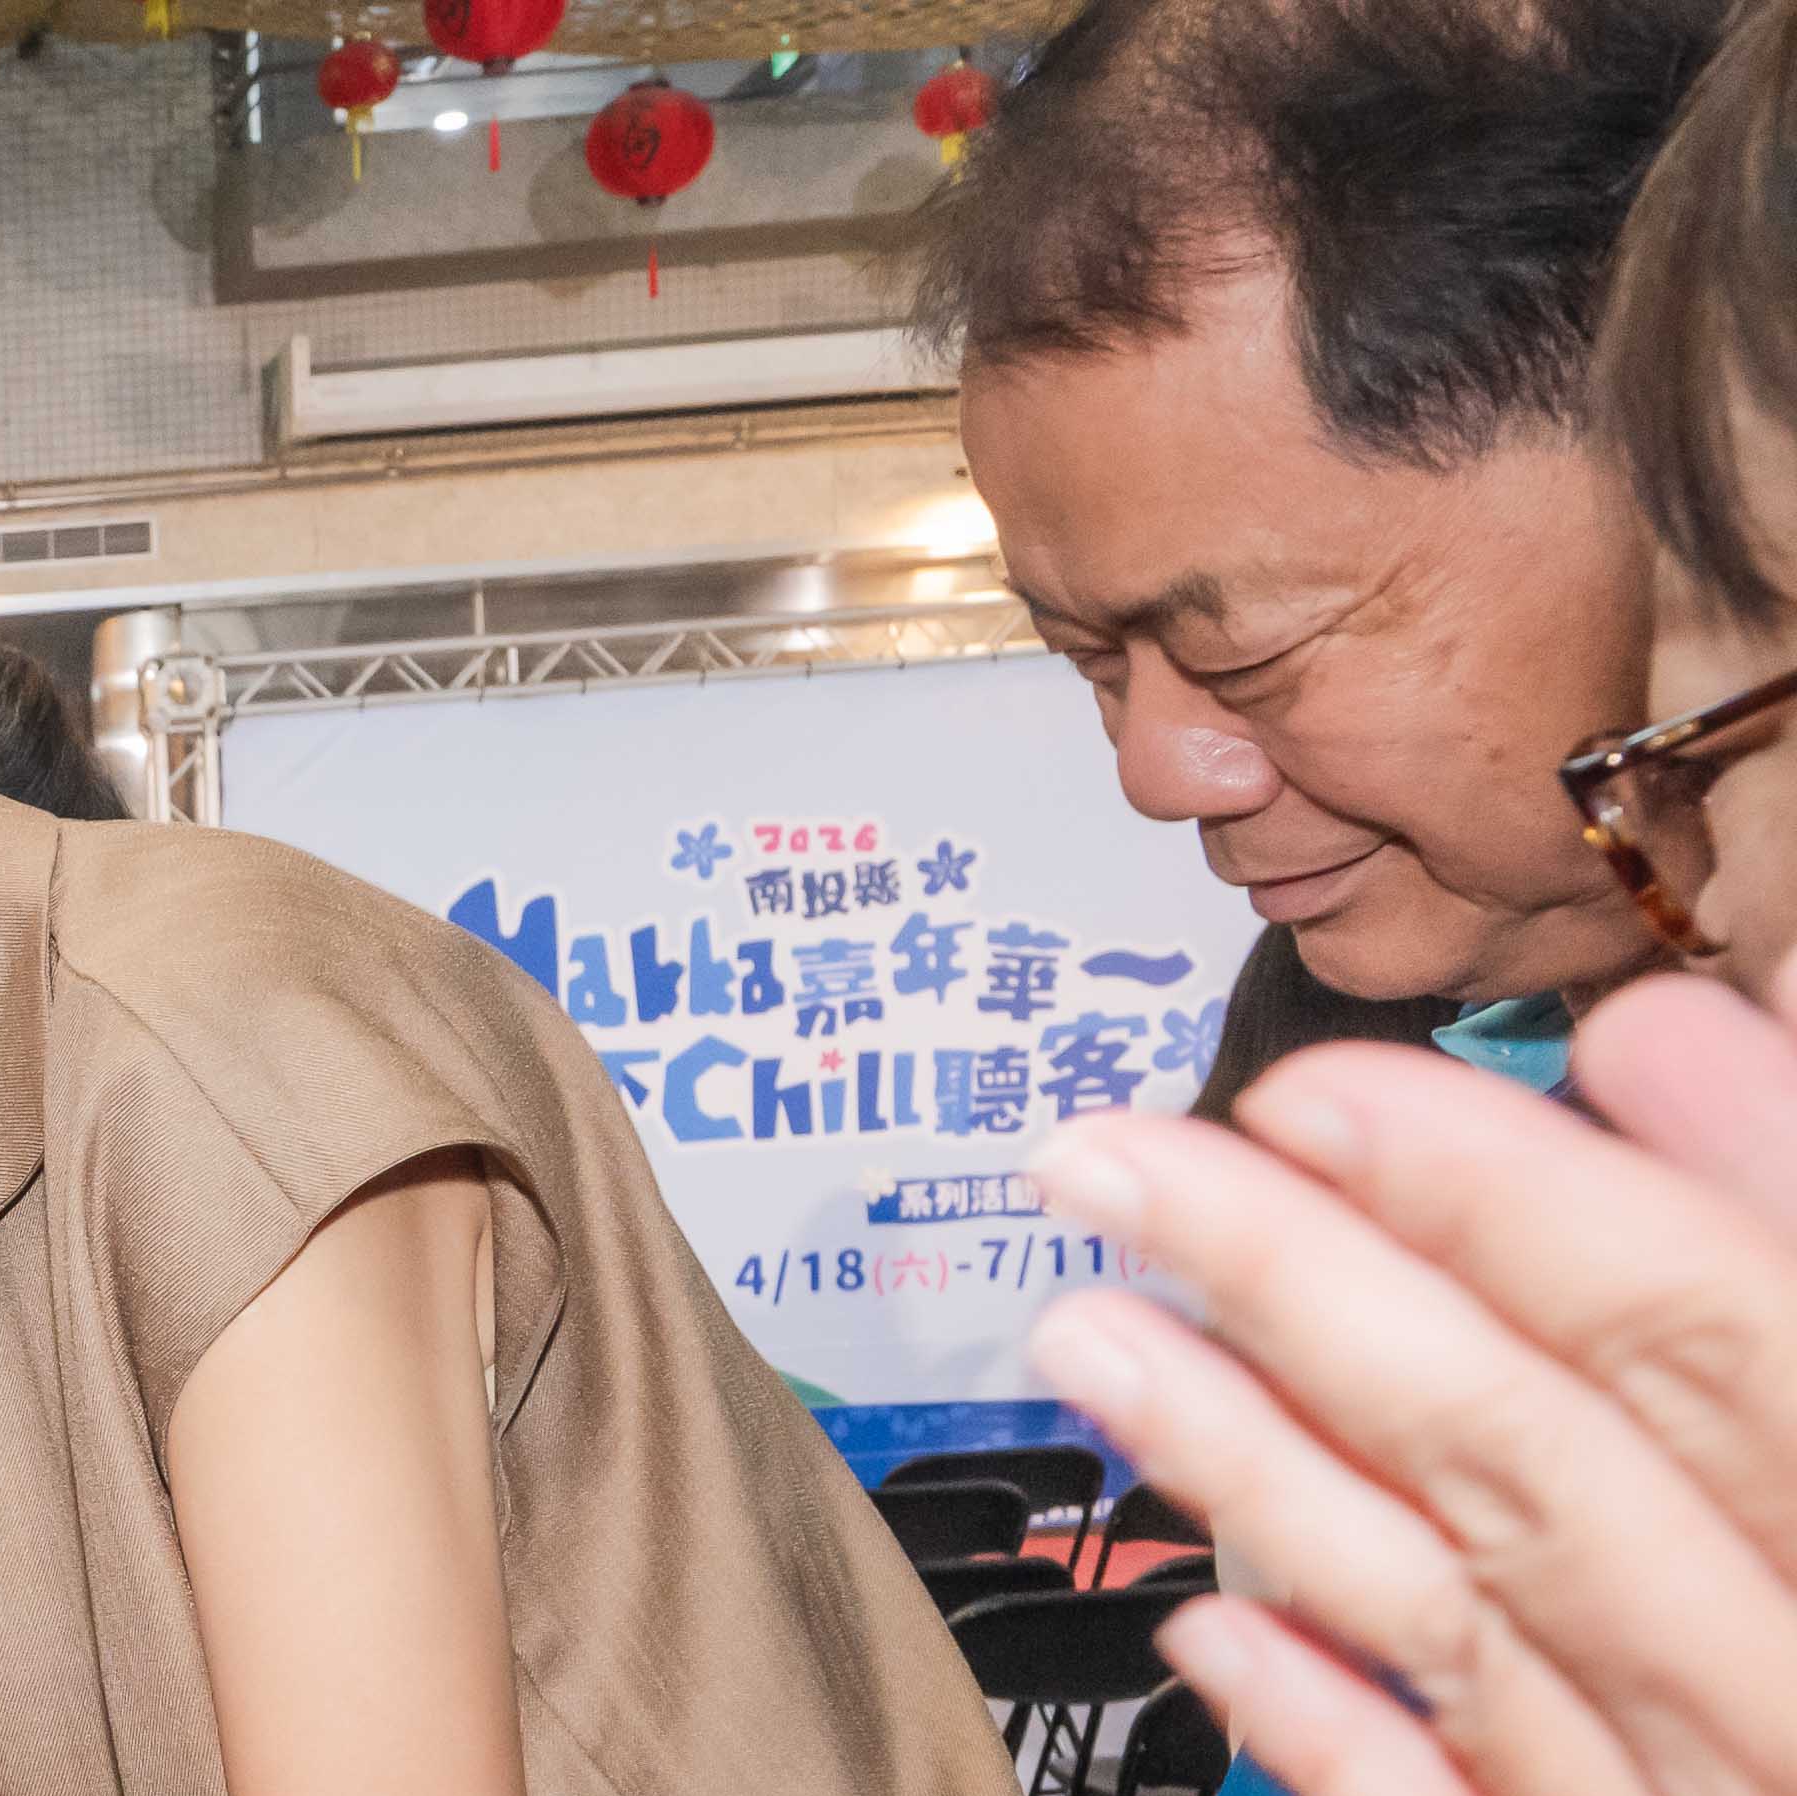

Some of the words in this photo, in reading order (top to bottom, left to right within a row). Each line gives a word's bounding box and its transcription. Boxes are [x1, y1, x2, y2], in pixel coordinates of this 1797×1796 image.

[754, 823, 880, 853] 2026
[746, 860, 902, 918] 南投縣
